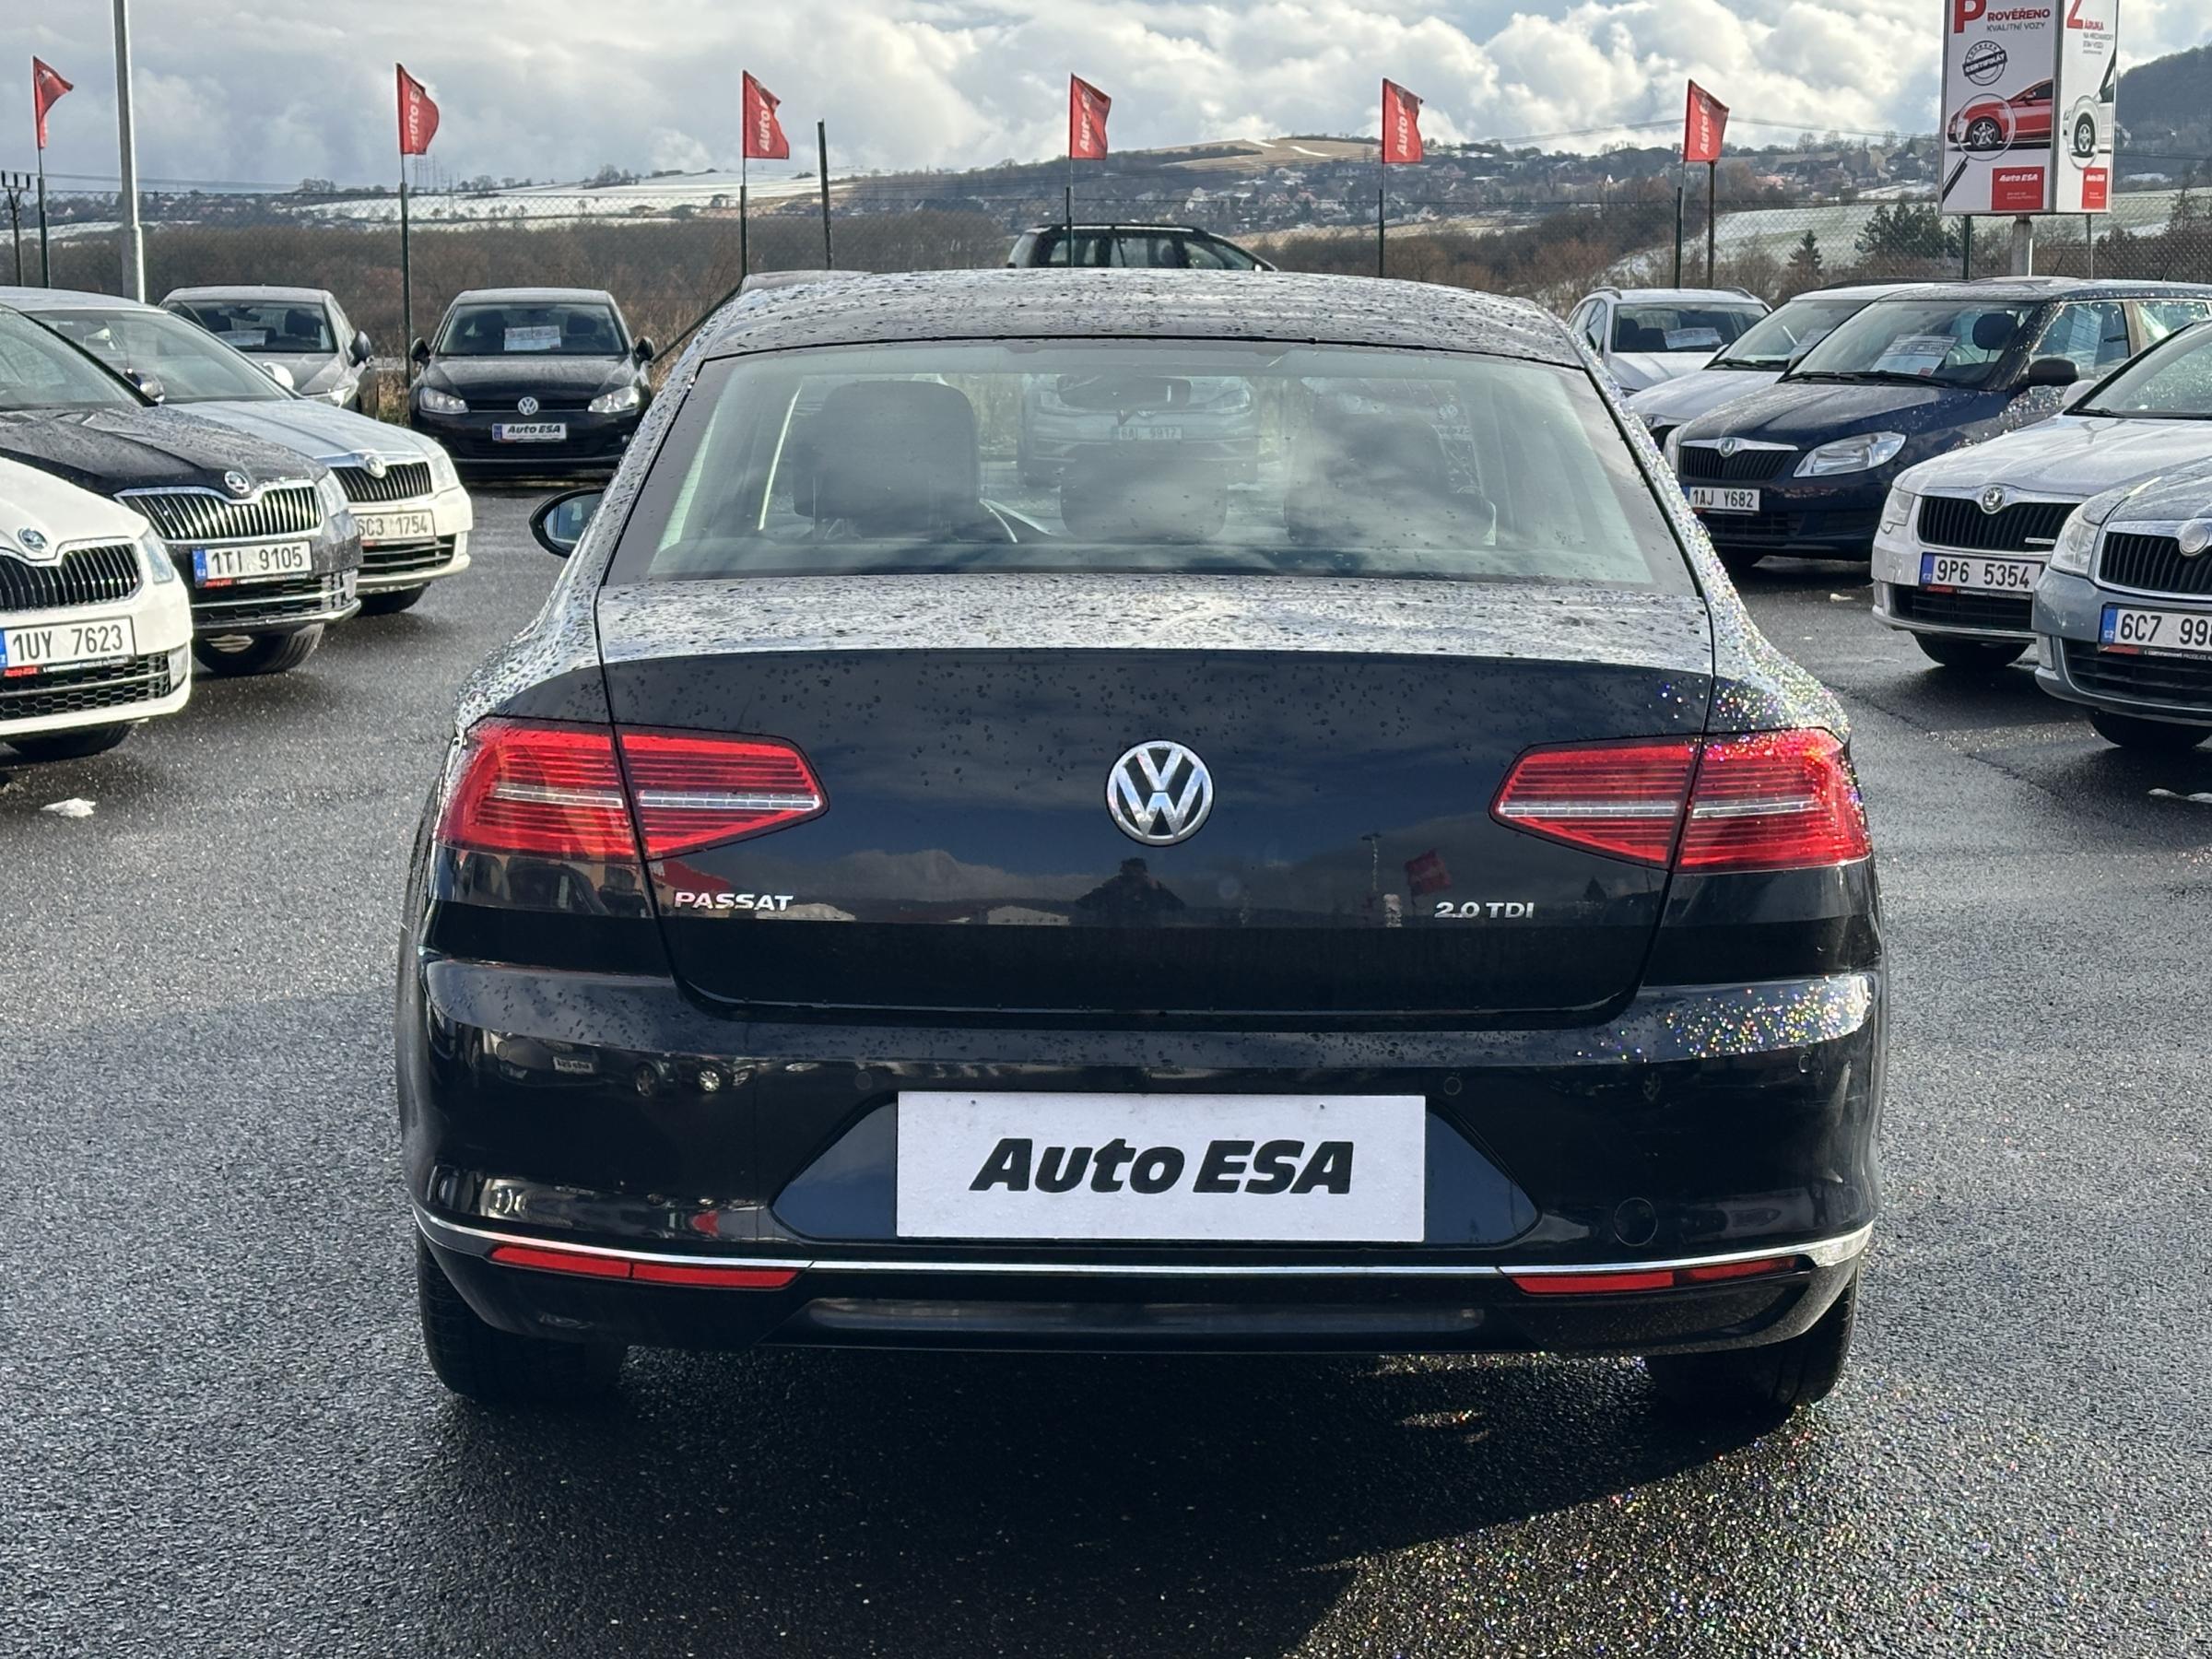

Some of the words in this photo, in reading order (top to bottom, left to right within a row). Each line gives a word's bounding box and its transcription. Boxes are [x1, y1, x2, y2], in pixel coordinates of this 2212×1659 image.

[1986, 21, 2022, 32] KVALITNÍ
[2024, 21, 2046, 30] VOZY
[759, 109, 771, 152] Auto
[1396, 116, 1408, 157] Auto
[1699, 114, 1710, 155] Auto
[508, 425, 537, 434] Auto
[538, 425, 560, 433] ESA
[1693, 489, 1714, 506] 1AJ
[1724, 490, 1754, 508] Y682
[395, 515, 428, 535] 1754
[212, 550, 242, 574] 1TI
[259, 546, 303, 571] 9105
[1936, 559, 1970, 582] 9P6
[1983, 563, 2030, 589] 5354
[13, 630, 53, 661] 1UY
[71, 625, 123, 655] 7623
[2120, 613, 2162, 642] 6C7
[2179, 618, 2212, 647] 99
[674, 891, 794, 912] PASSAT
[1434, 901, 1480, 919] 2.0
[1485, 901, 1535, 919] TDI
[968, 1137, 1185, 1194] Auto
[1192, 1139, 1354, 1194] ESA
